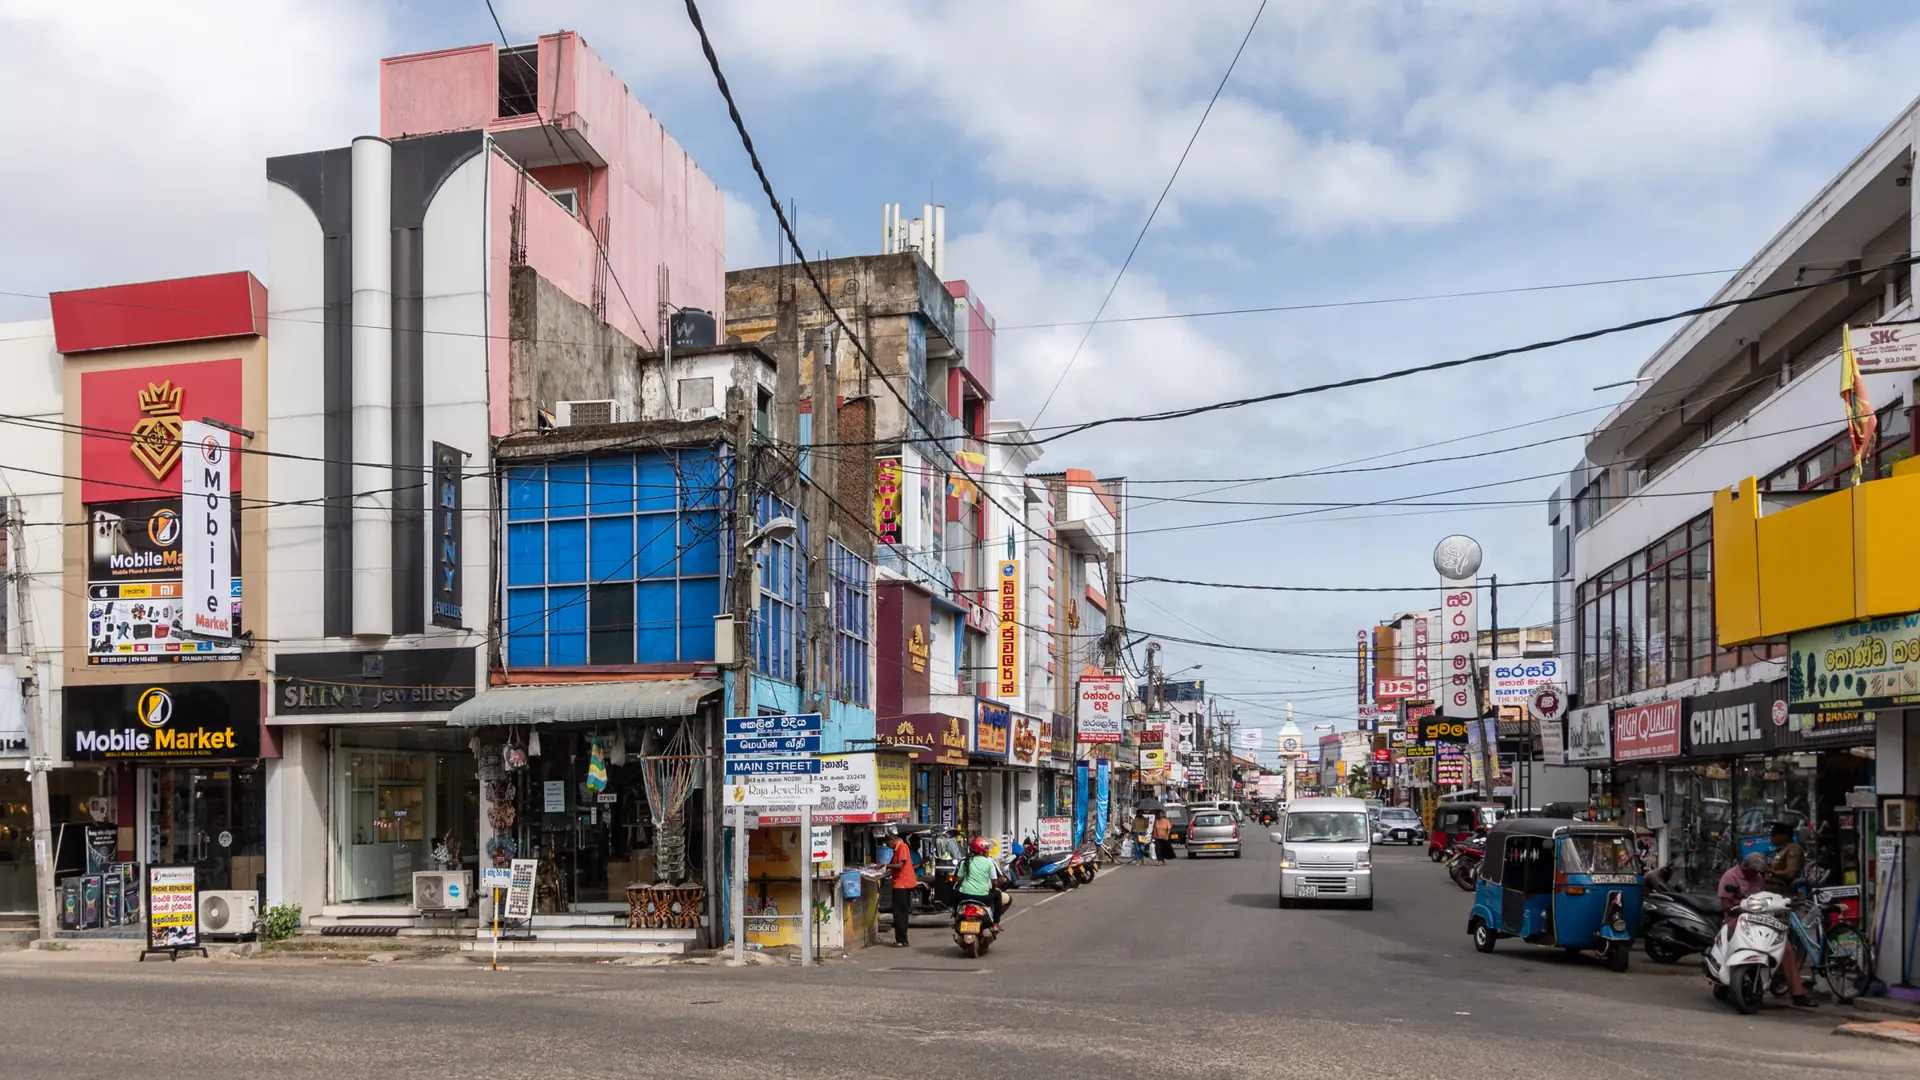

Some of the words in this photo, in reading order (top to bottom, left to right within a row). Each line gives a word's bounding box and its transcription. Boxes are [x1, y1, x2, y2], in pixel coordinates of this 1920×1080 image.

[1870, 329, 1899, 345] SKC
[204, 468, 221, 612] Mobile
[110, 551, 183, 569] MobileMa
[433, 600, 463, 619] JEWELLERS
[195, 613, 229, 631] Market
[1848, 618, 1901, 636] GRADE
[1825, 636, 1887, 671] කොණ්ඩ
[1495, 661, 1556, 678] සරසවි
[1384, 681, 1413, 693] DS
[1499, 679, 1525, 687] පොත්
[284, 685, 362, 709] SHINY
[370, 684, 464, 709] Jewellers
[1083, 691, 1121, 700] රත්තරං
[1617, 712, 1637, 742] HIGH
[1638, 704, 1677, 742] QUALITY
[1690, 702, 1762, 746] CHANEL
[76, 728, 150, 752] Mobile
[155, 726, 236, 750] Market
[877, 732, 936, 746] KRISHNA
[734, 762, 763, 771] MAIN
[766, 761, 812, 770] STREET
[748, 784, 768, 797] Raja
[770, 784, 815, 795] Jewellers
[374, 820, 391, 829] OPEN
